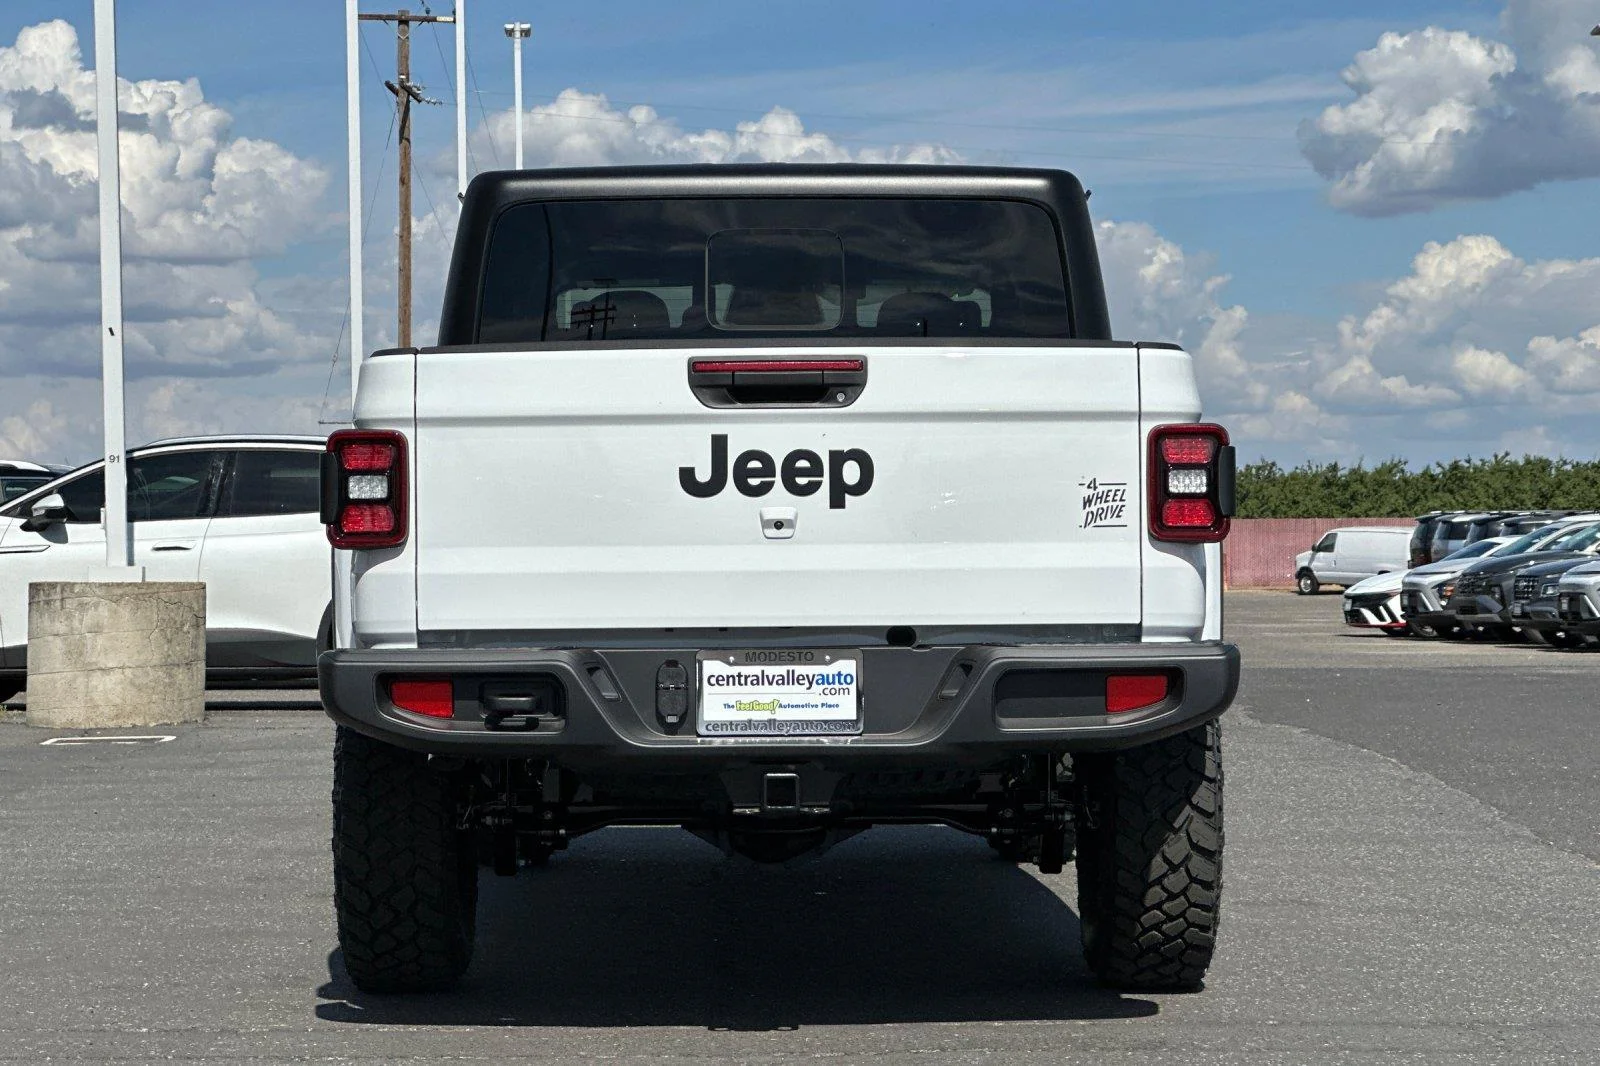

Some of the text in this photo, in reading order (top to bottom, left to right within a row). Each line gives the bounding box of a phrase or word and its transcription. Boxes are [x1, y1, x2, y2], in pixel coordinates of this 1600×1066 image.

[109, 454, 120, 463] 91
[678, 433, 875, 509] Jeep
[1086, 477, 1098, 491] 4
[1082, 488, 1126, 510] WHEEL
[1083, 504, 1126, 529] DRIVE
[744, 650, 815, 663] MODESTO
[706, 669, 854, 690] centralvalleyauto
[705, 718, 858, 735] centralvalleyauto.com
